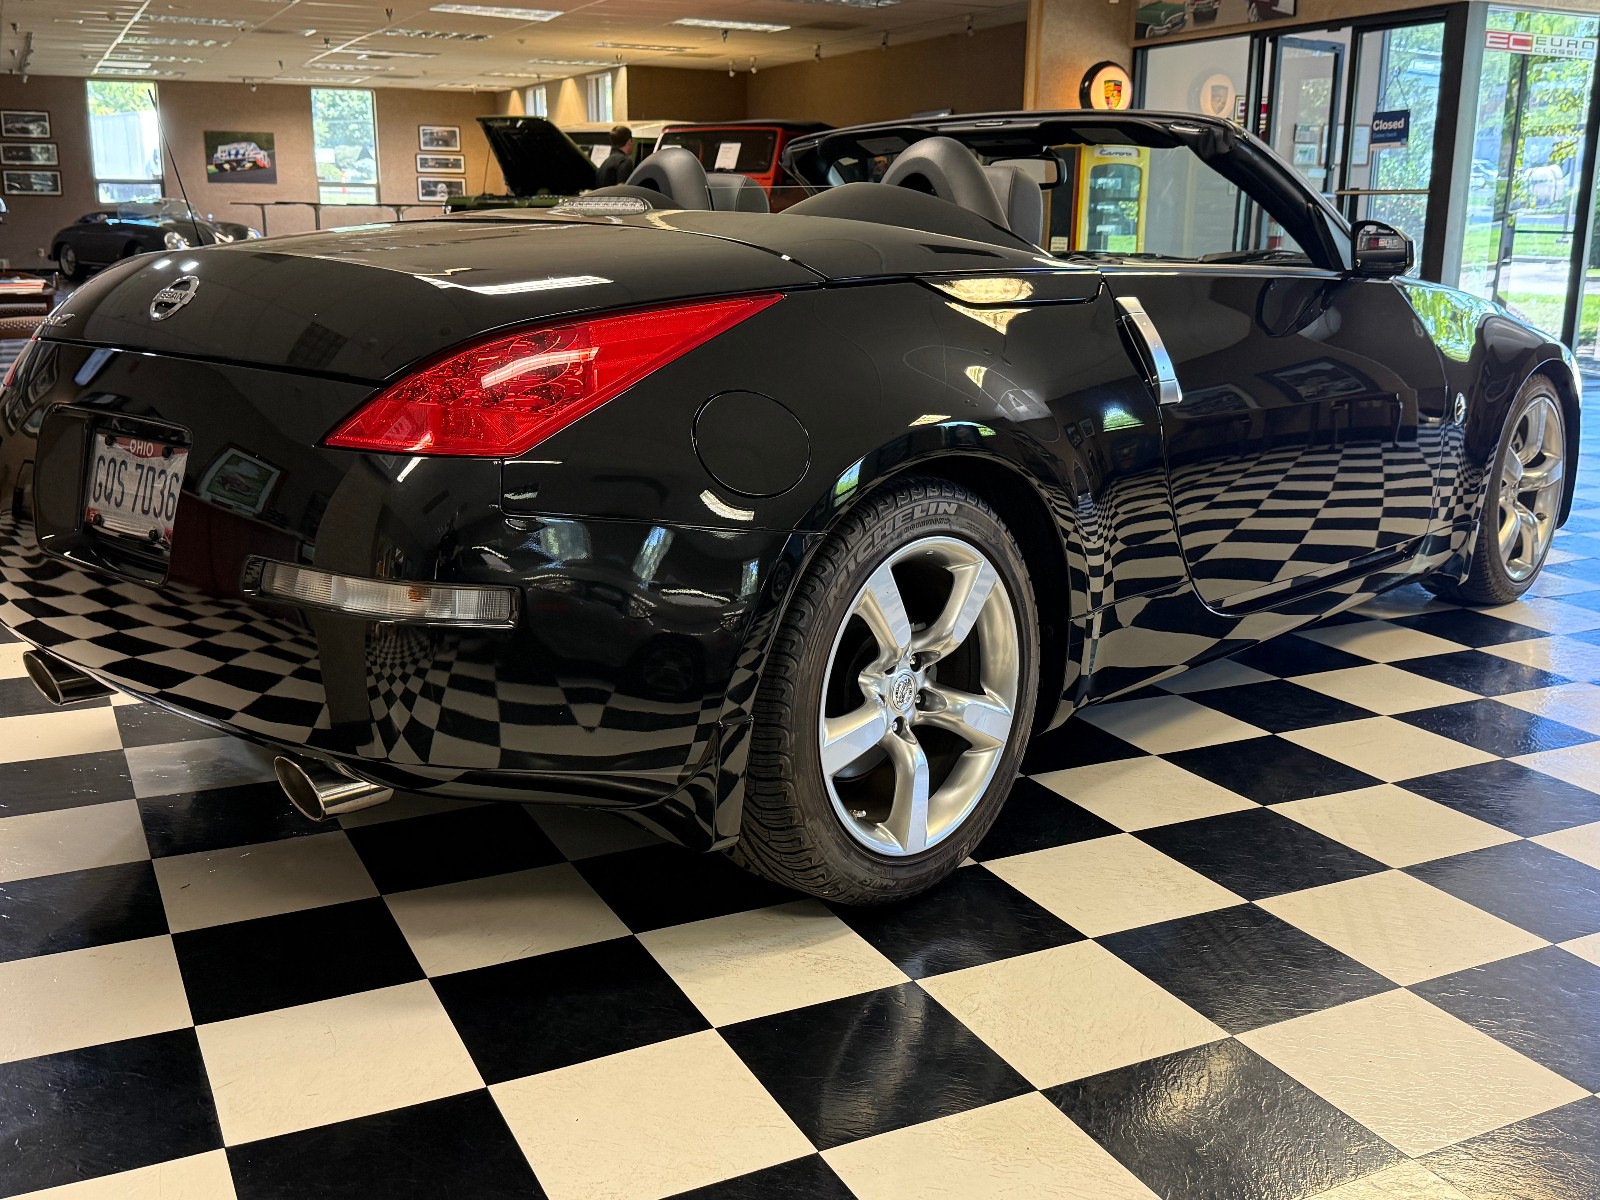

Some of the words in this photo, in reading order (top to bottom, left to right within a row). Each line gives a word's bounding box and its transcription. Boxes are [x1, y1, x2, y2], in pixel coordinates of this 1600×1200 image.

[1536, 36, 1595, 50] EURO
[1372, 118, 1405, 131] Closed
[129, 438, 154, 457] OHIO
[92, 455, 128, 508] GQS
[131, 463, 180, 522] 7036
[825, 501, 958, 611] MICHELIN
